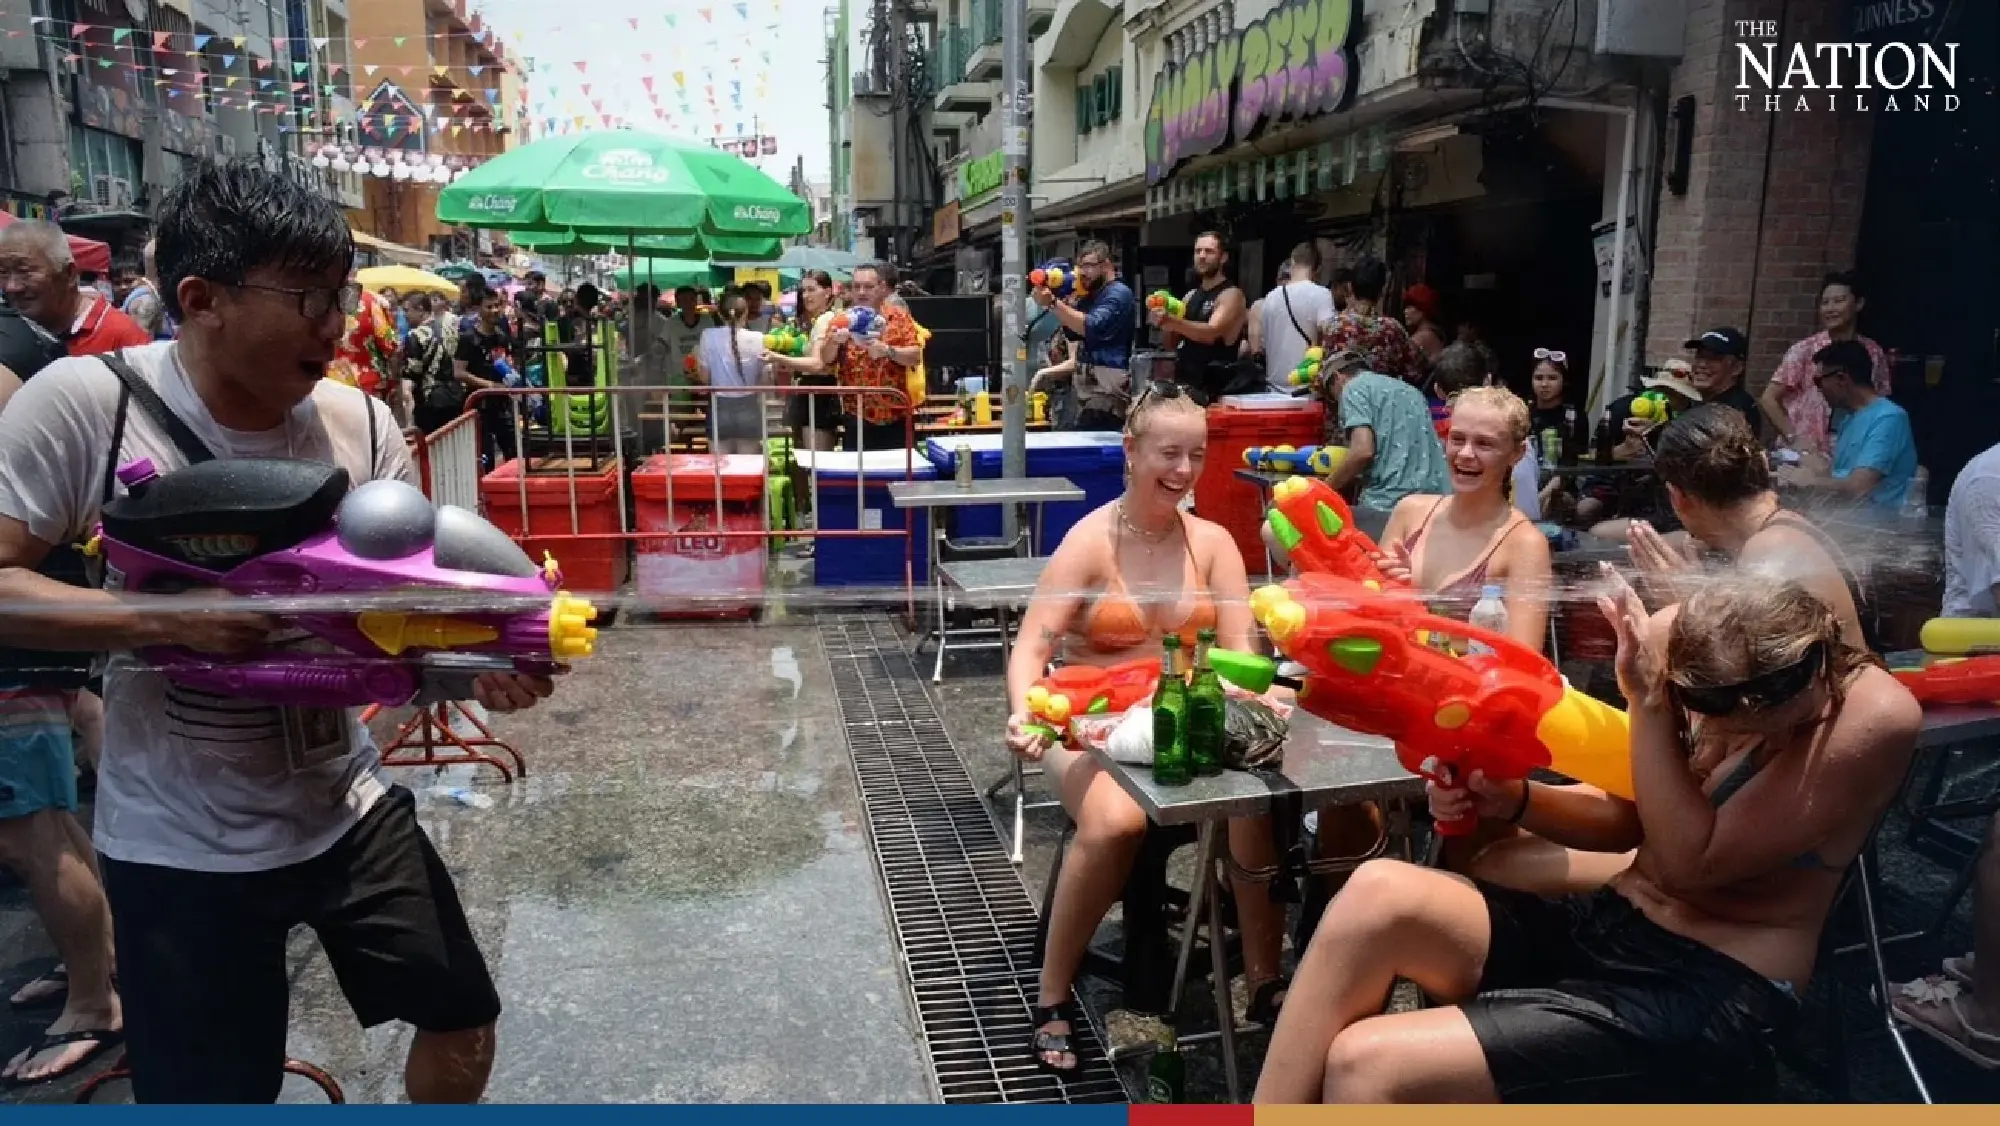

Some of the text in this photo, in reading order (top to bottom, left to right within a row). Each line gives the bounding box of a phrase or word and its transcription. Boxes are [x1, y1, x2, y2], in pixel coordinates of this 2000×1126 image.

[581, 164, 672, 184] Chang
[485, 194, 517, 213] Chang
[748, 204, 780, 223] Chang
[680, 535, 719, 549] LEO
